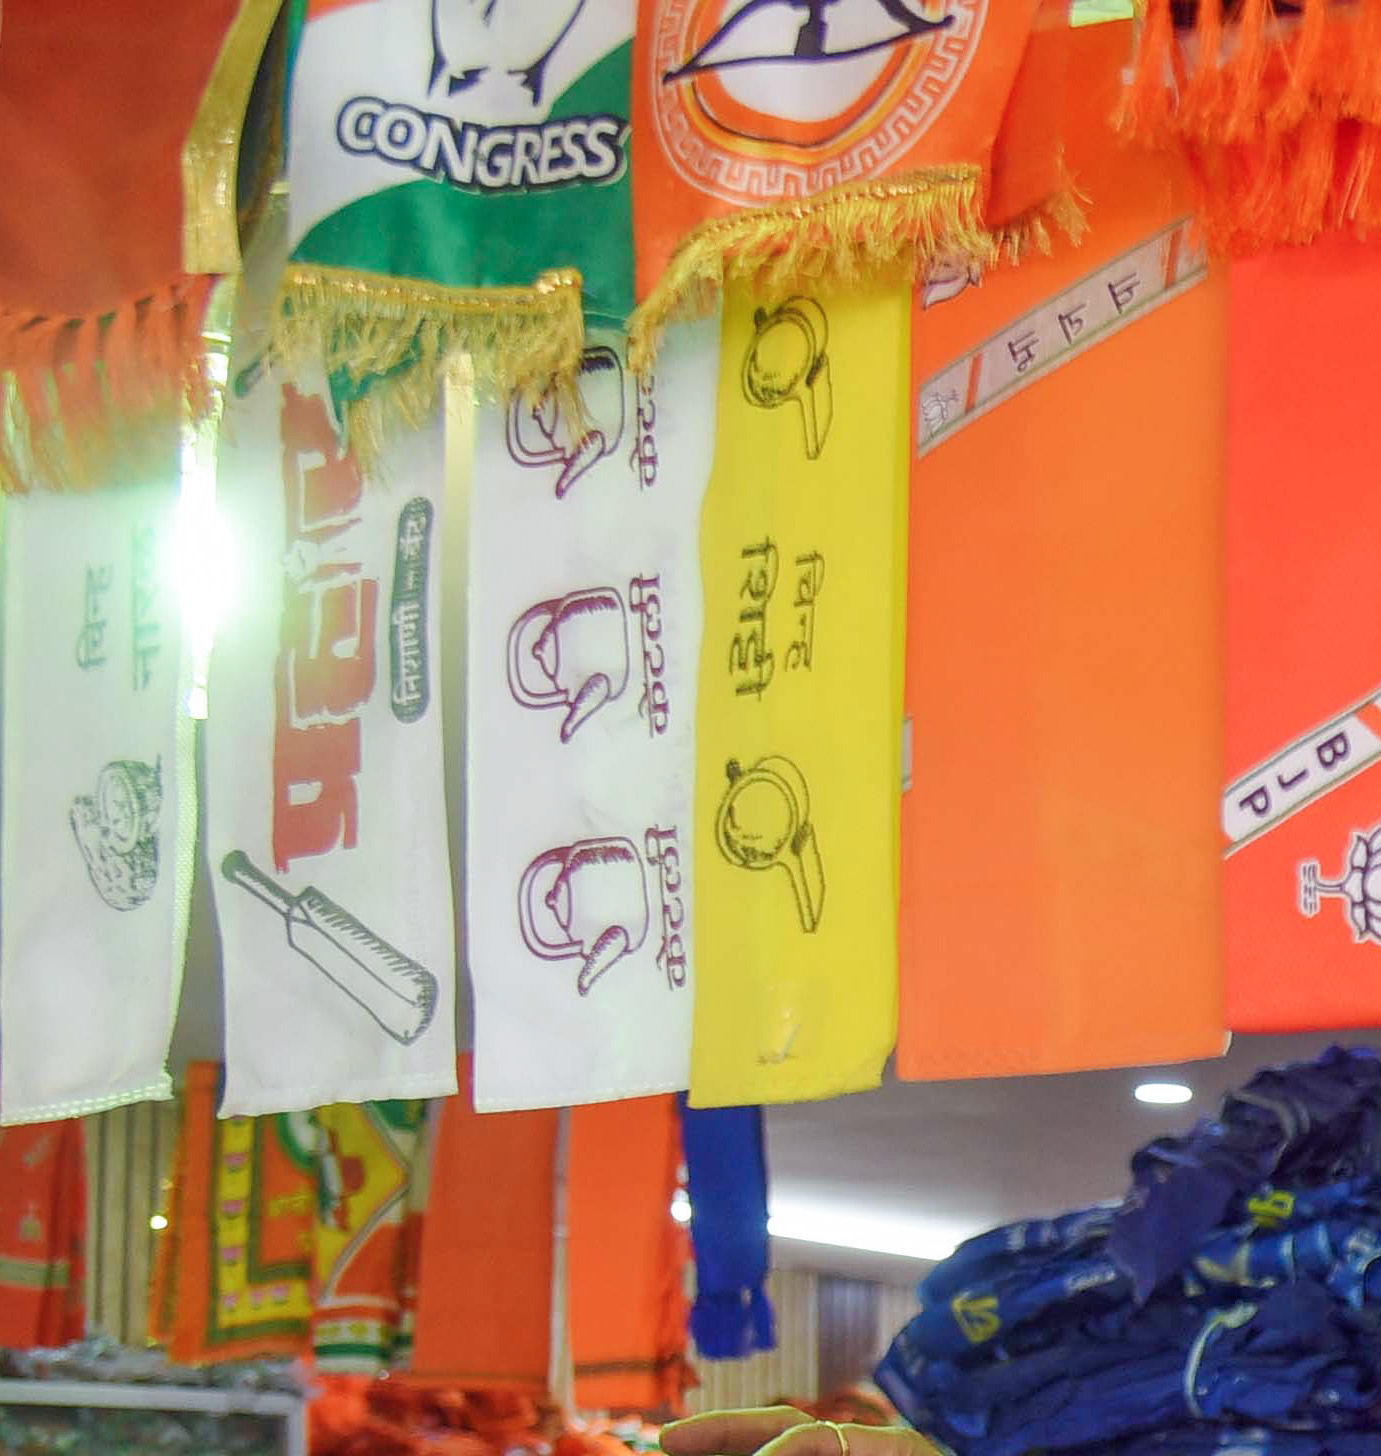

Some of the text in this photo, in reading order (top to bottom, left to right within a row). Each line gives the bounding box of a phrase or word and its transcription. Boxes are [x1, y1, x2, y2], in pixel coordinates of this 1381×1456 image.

[337, 96, 624, 190] CONGRESS
[628, 573, 671, 738] केटली
[1238, 730, 1349, 820] BJP
[644, 825, 688, 990] केटली
